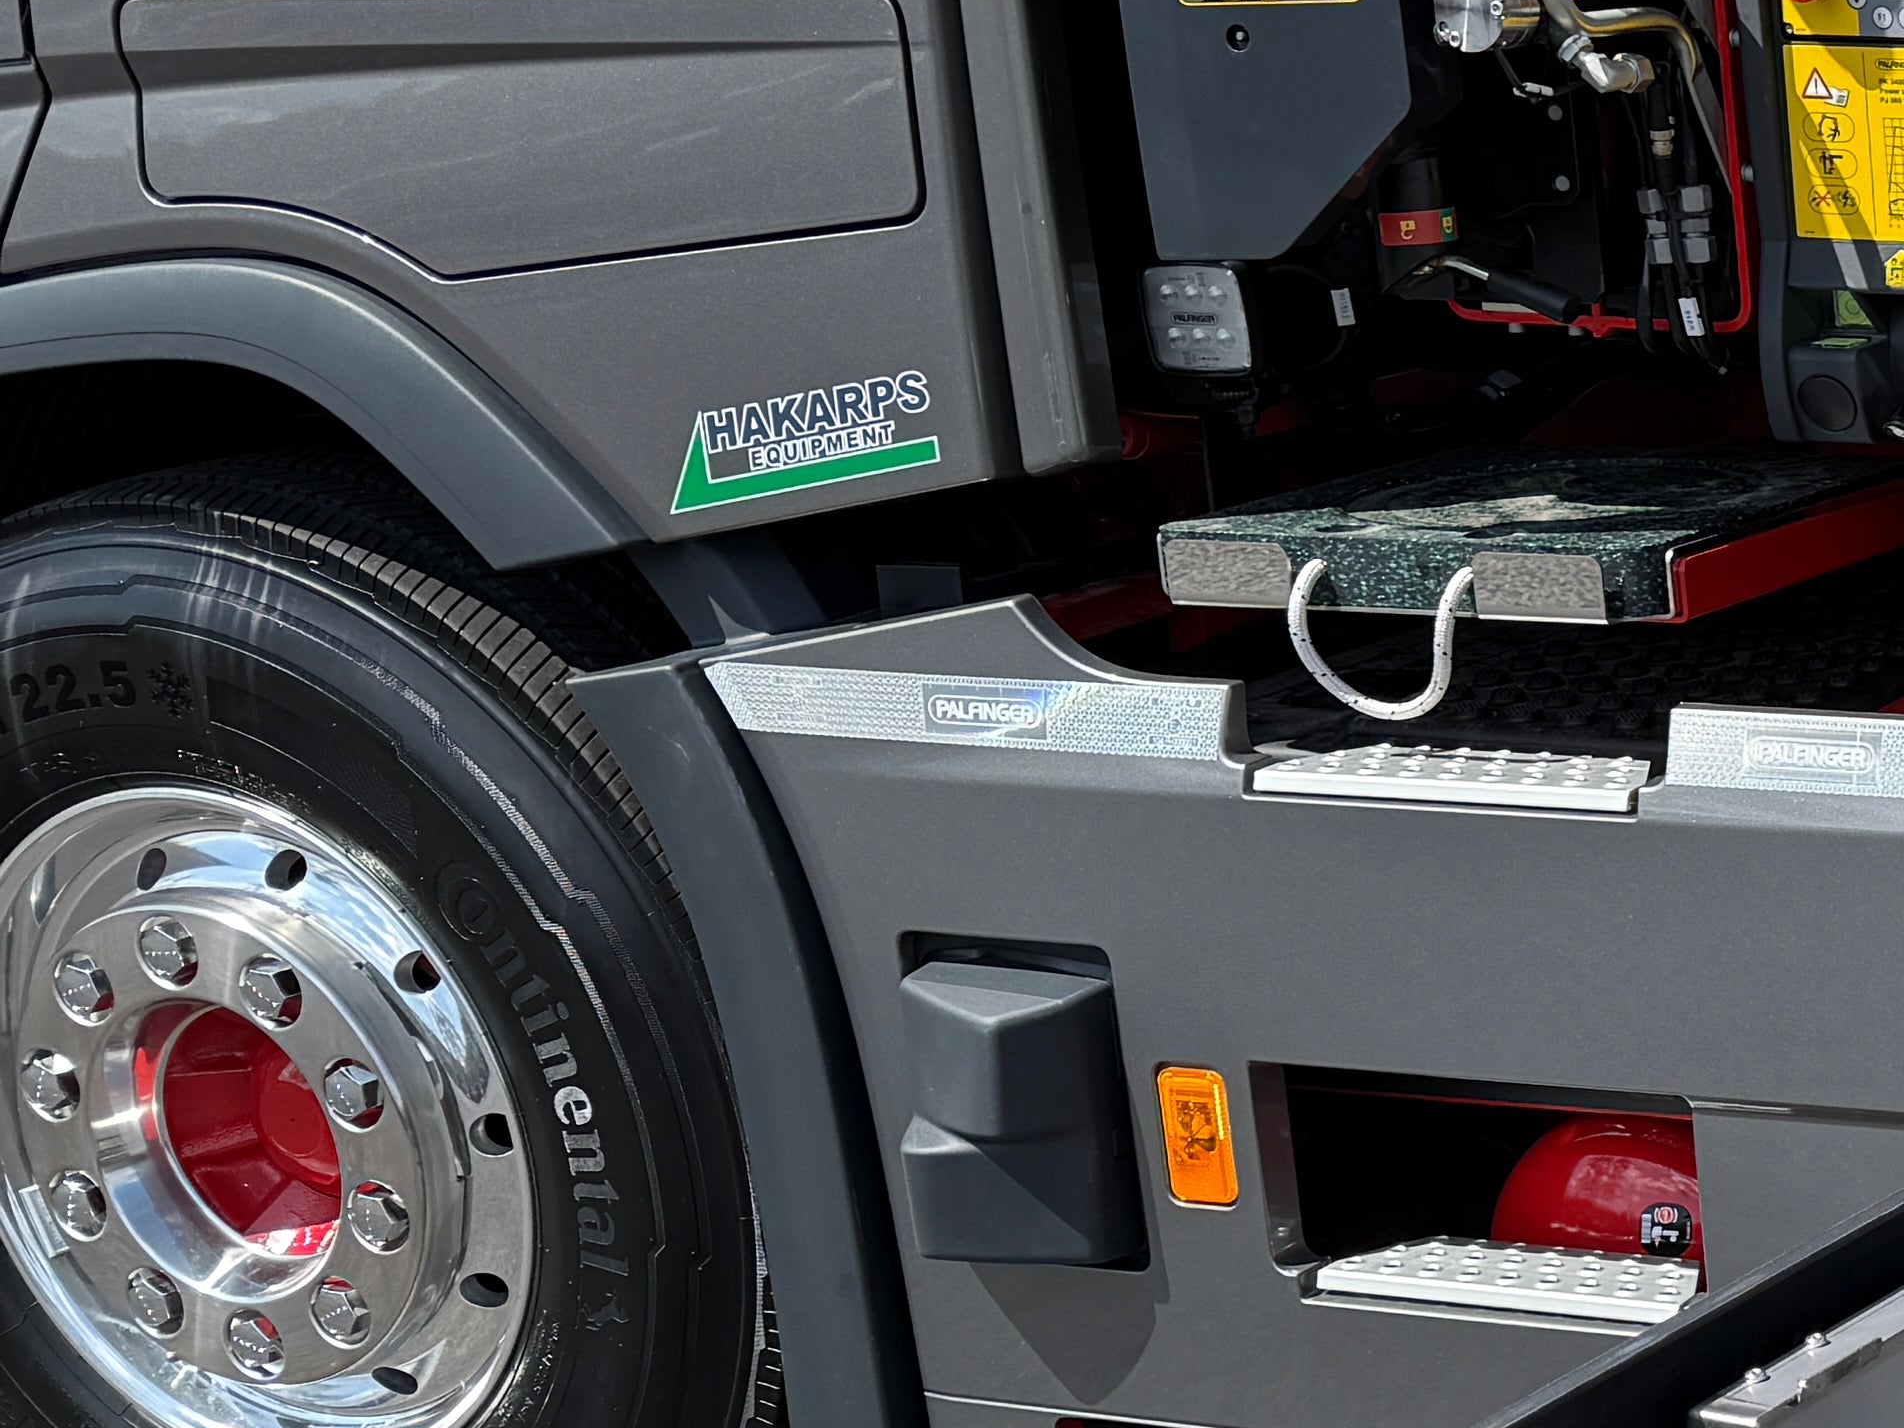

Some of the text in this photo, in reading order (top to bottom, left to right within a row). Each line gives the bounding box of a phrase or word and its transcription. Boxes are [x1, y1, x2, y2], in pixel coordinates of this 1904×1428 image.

[703, 370, 931, 454] HAKARPS
[749, 420, 895, 471] EQUIPMENT
[10, 660, 137, 724] 22.5
[935, 700, 1034, 724] PALFINGER
[1759, 744, 1867, 768] PALFINGER
[437, 861, 630, 1276] Continental
